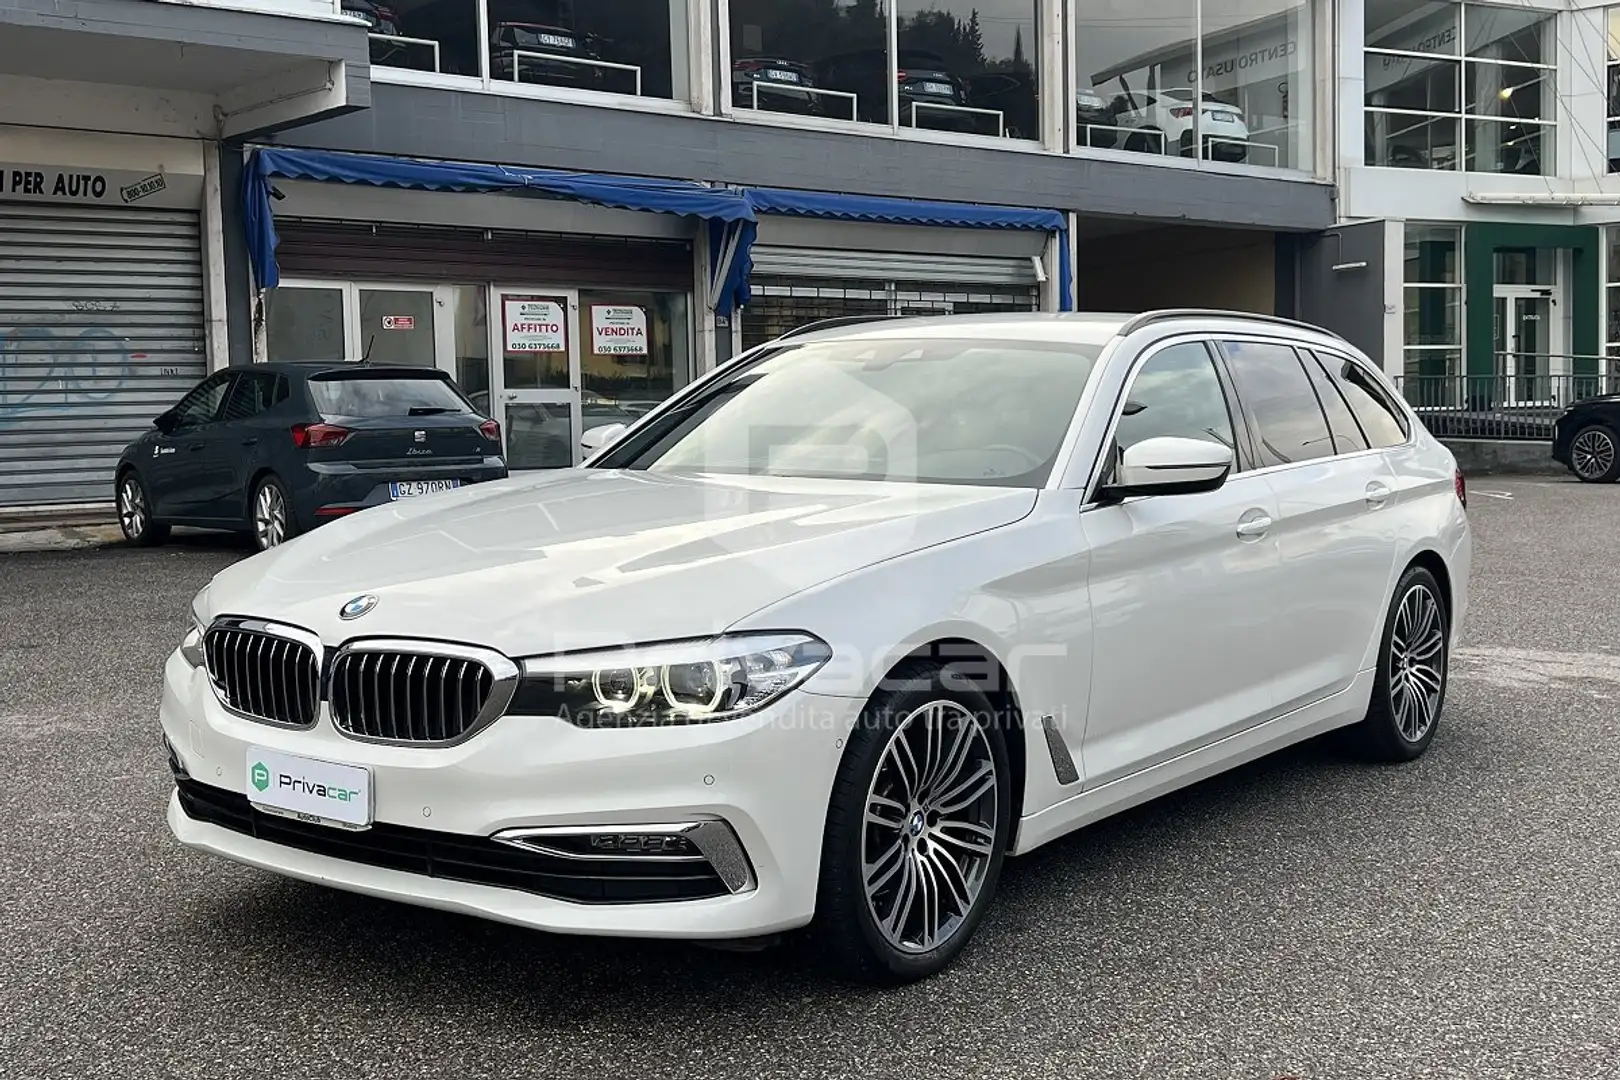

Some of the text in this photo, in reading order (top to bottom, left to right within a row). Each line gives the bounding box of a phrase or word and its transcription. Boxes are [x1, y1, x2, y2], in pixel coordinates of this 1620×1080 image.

[12, 171, 45, 194] PER
[52, 173, 107, 198] AUTO
[511, 323, 559, 333] AFFITTO
[596, 326, 643, 336] VENDITA
[399, 481, 413, 496] GZ
[279, 774, 359, 802] Privacar
